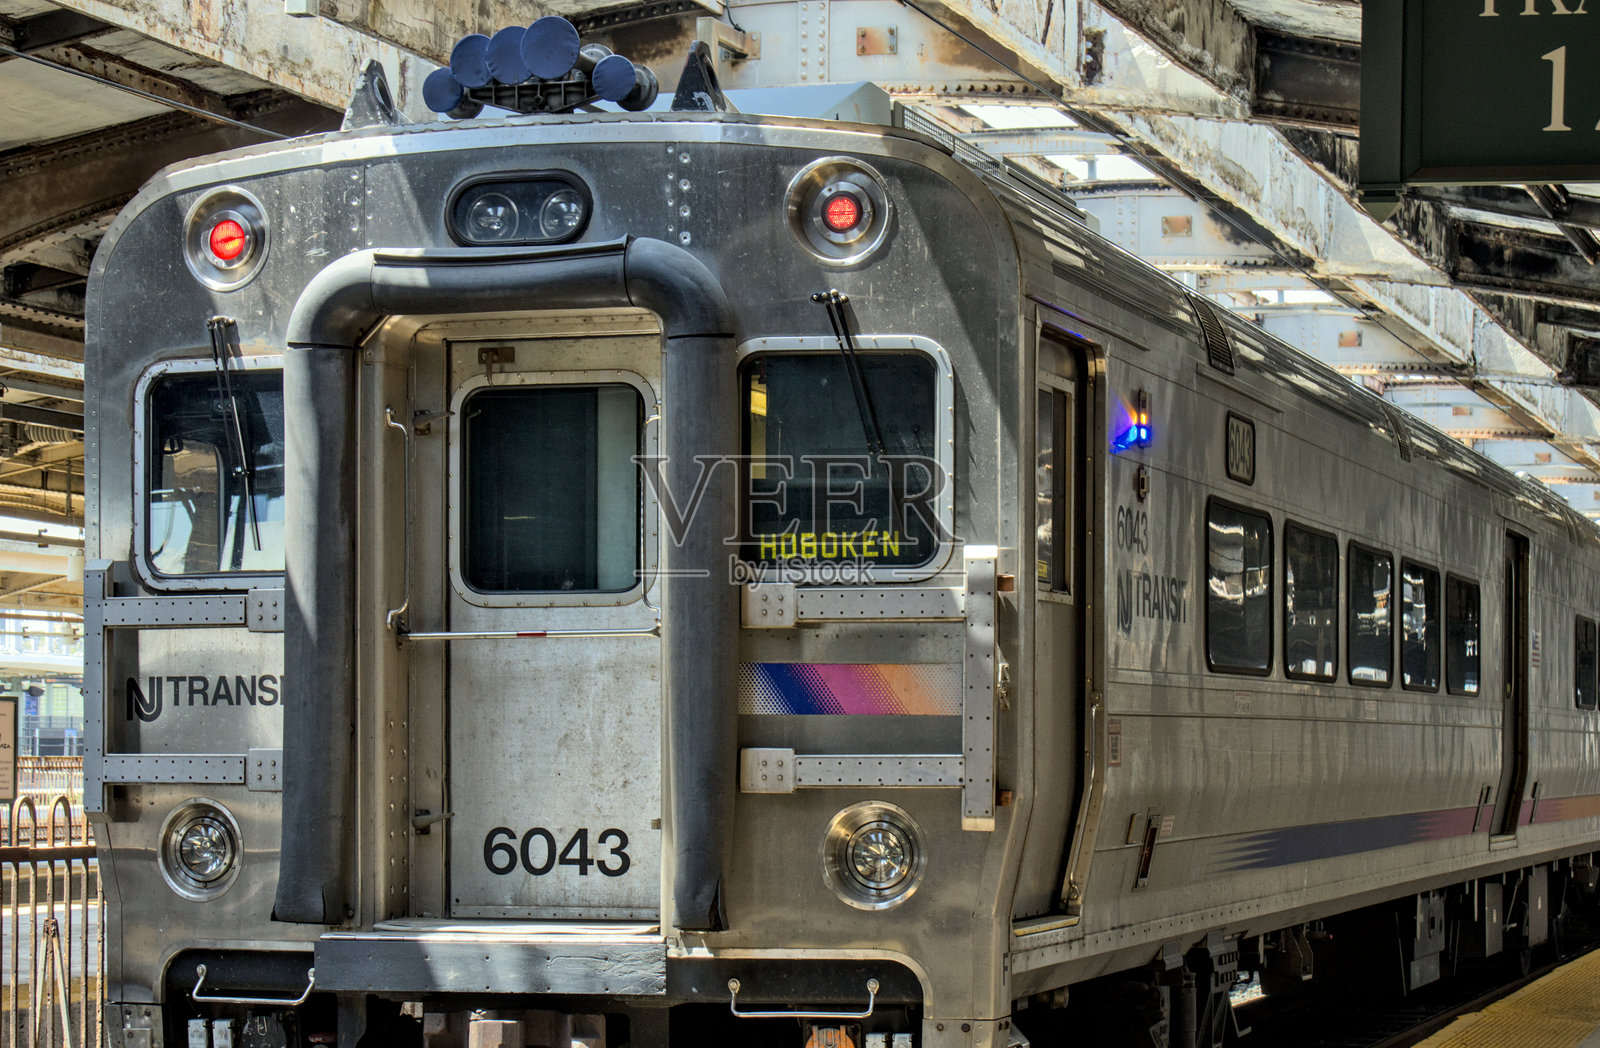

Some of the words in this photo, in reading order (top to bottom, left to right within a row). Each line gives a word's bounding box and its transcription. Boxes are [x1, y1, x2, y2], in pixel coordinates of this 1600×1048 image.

[1229, 422, 1252, 472] 6043
[760, 531, 900, 560] HOBOKEN
[1117, 505, 1148, 556] 6043
[484, 827, 630, 876] 6043
